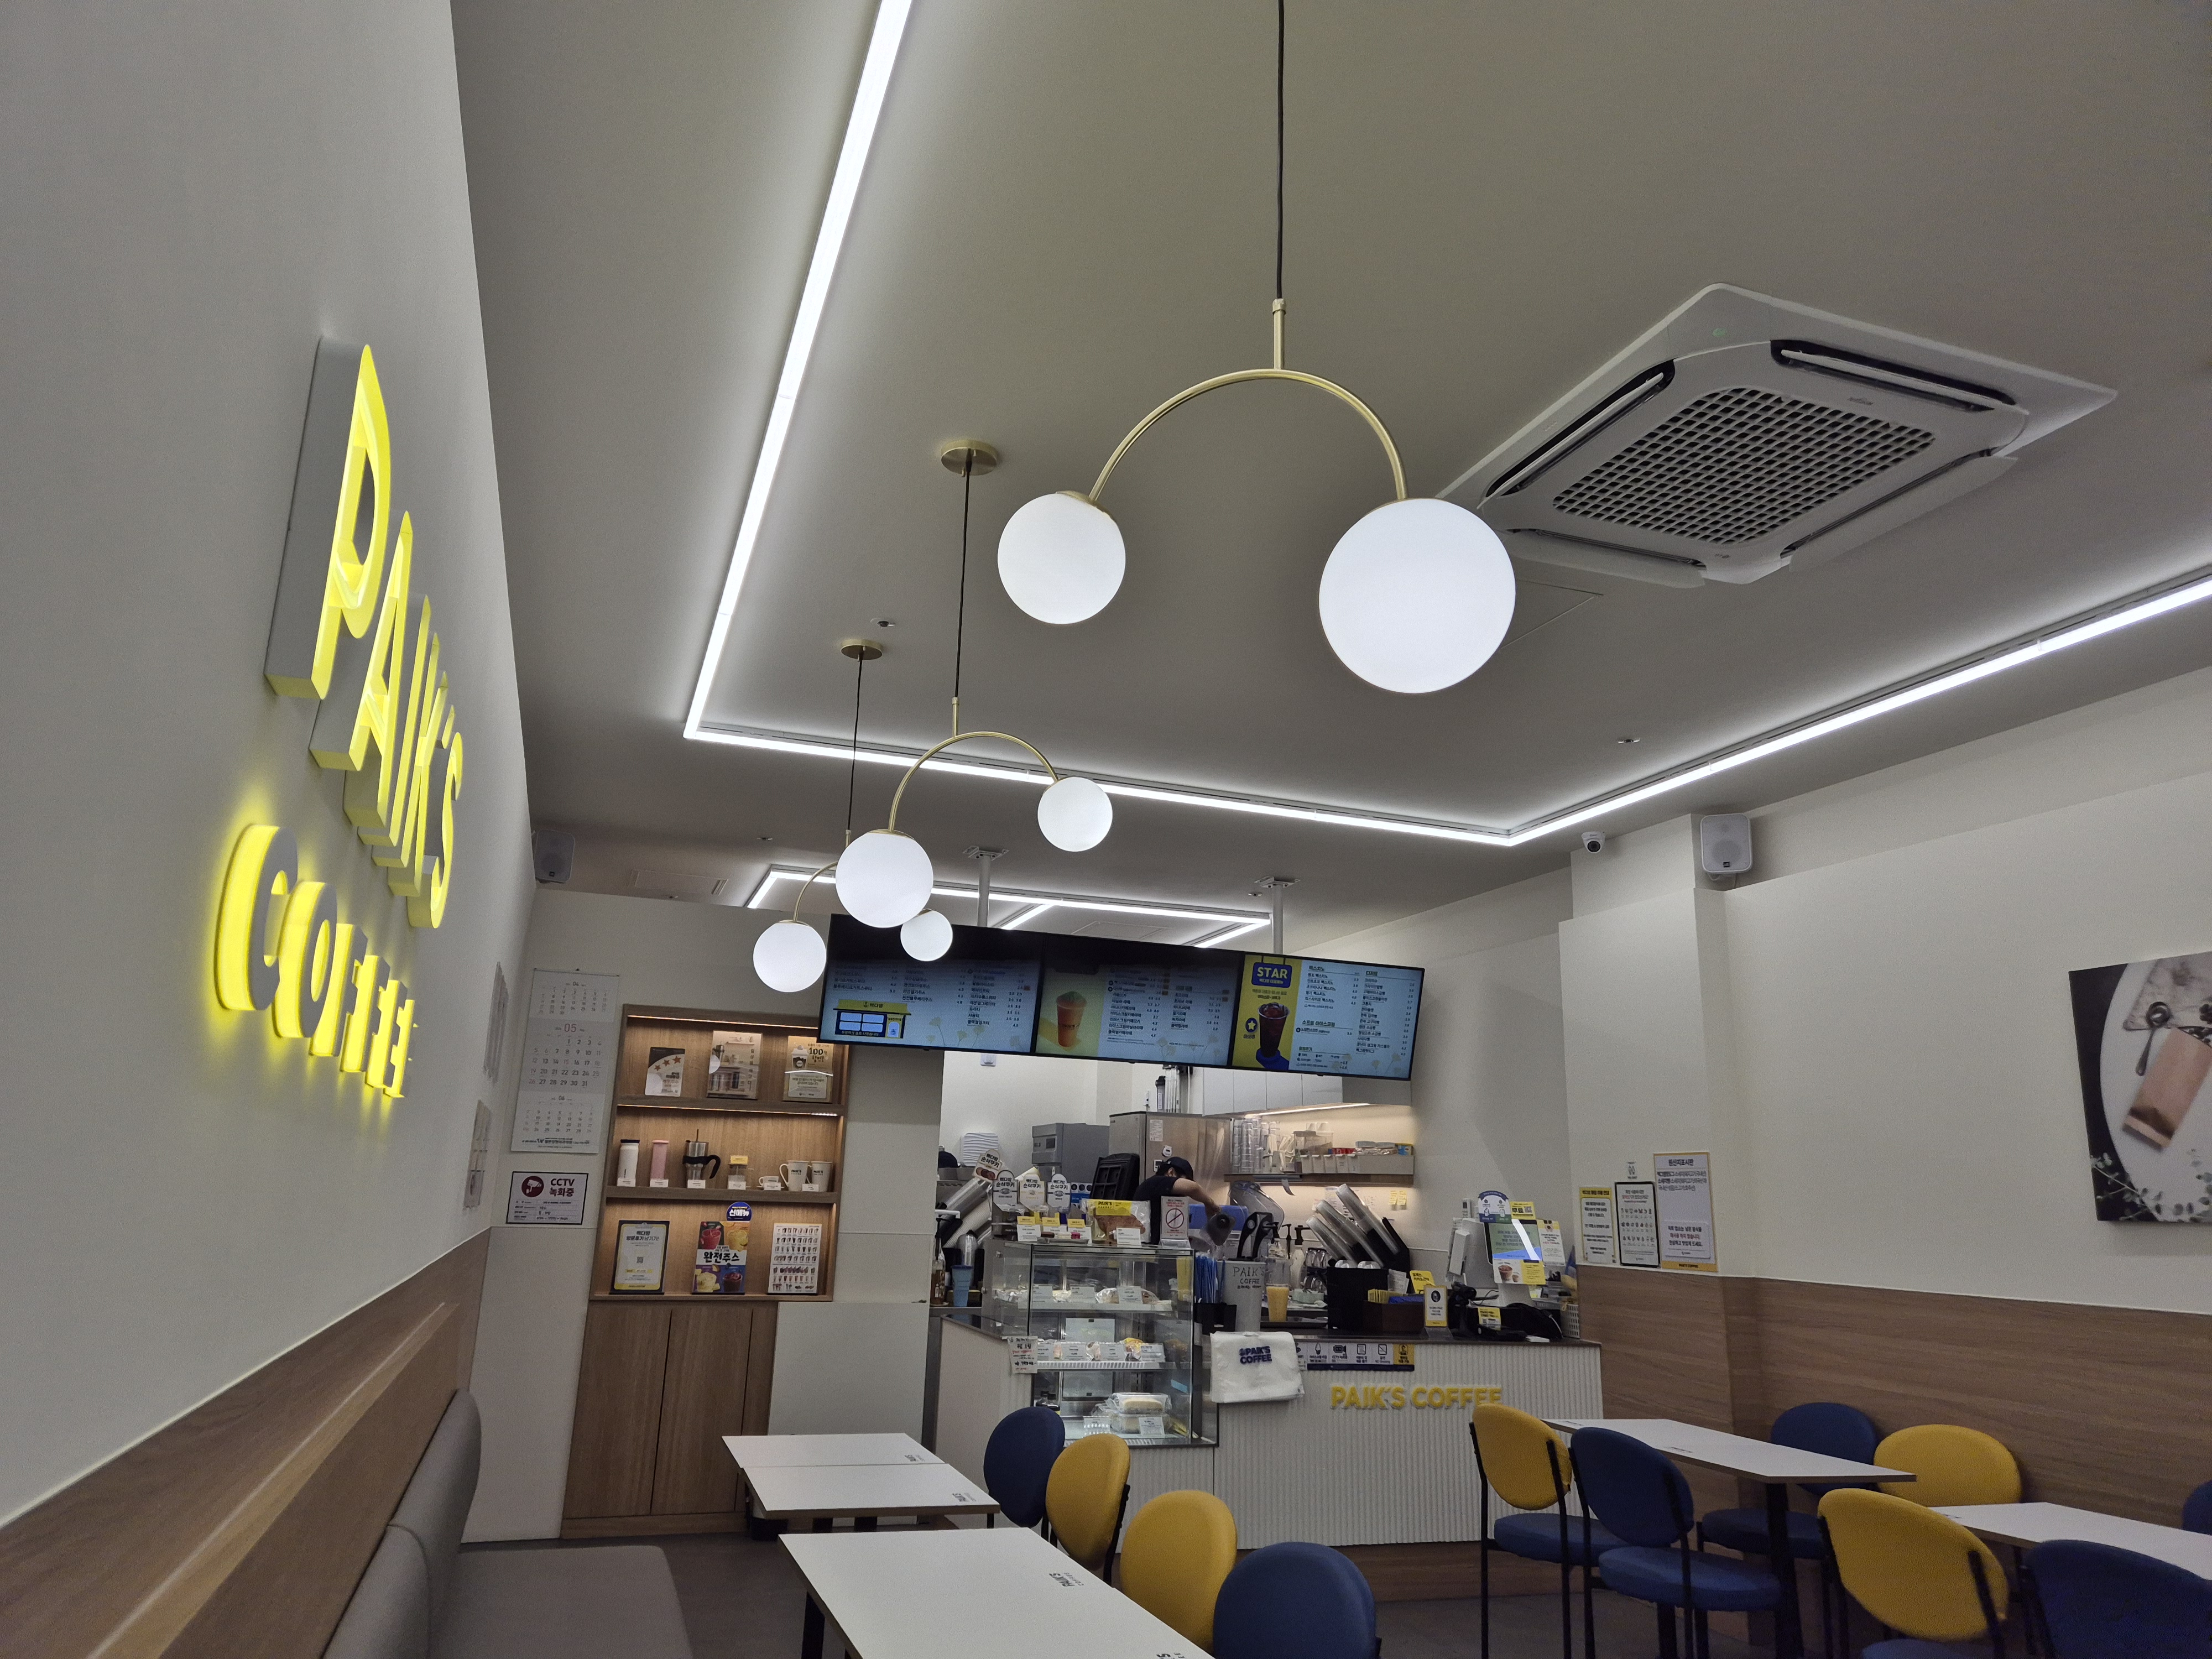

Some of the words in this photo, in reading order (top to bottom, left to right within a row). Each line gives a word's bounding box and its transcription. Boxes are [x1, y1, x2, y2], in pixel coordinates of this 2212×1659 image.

[1257, 967, 1288, 979] STAR
[565, 1024, 576, 1032] 05
[986, 1153, 999, 1161] 빽다방
[549, 1188, 574, 1197] 녹화중
[703, 1251, 739, 1264] 완전주스
[1245, 1346, 1271, 1355] PAIK'S
[1240, 1354, 1272, 1364] COFFEE
[1331, 1386, 1405, 1408] PAIK'S
[1411, 1386, 1502, 1408] COFFEE
